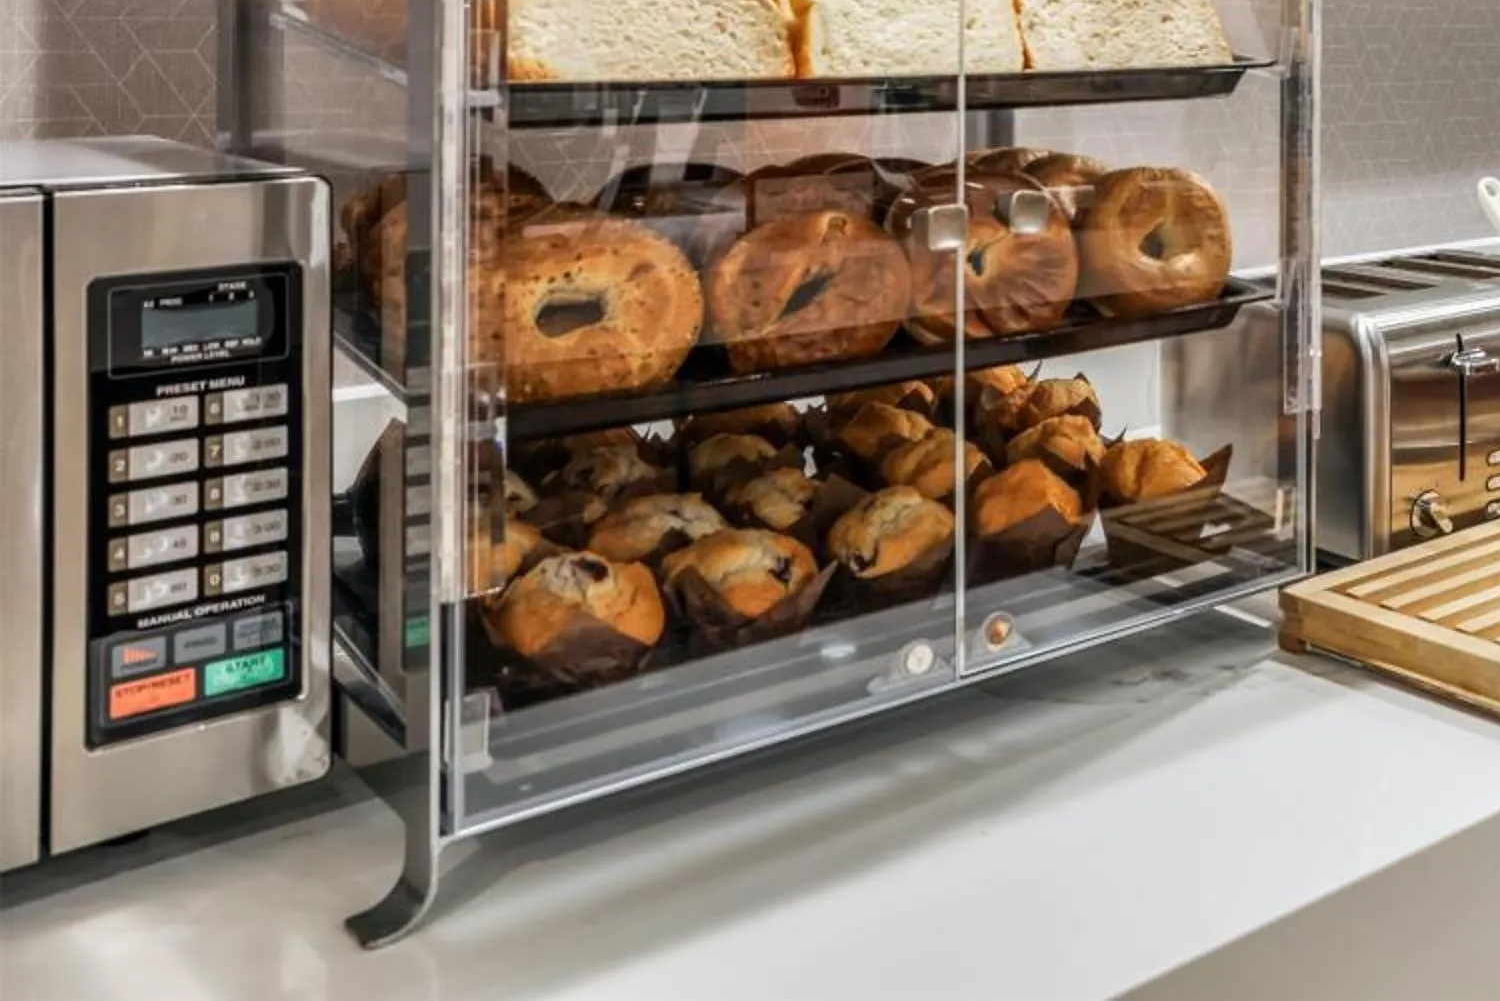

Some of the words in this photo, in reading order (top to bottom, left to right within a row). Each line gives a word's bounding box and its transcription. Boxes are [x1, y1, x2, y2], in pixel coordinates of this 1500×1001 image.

[156, 379, 206, 397] PRESET
[209, 374, 245, 390] MENU
[210, 445, 221, 458] 7
[115, 459, 126, 472] 2
[137, 611, 193, 629] MANUAL
[193, 594, 266, 617] OPERATION
[225, 655, 266, 673] START
